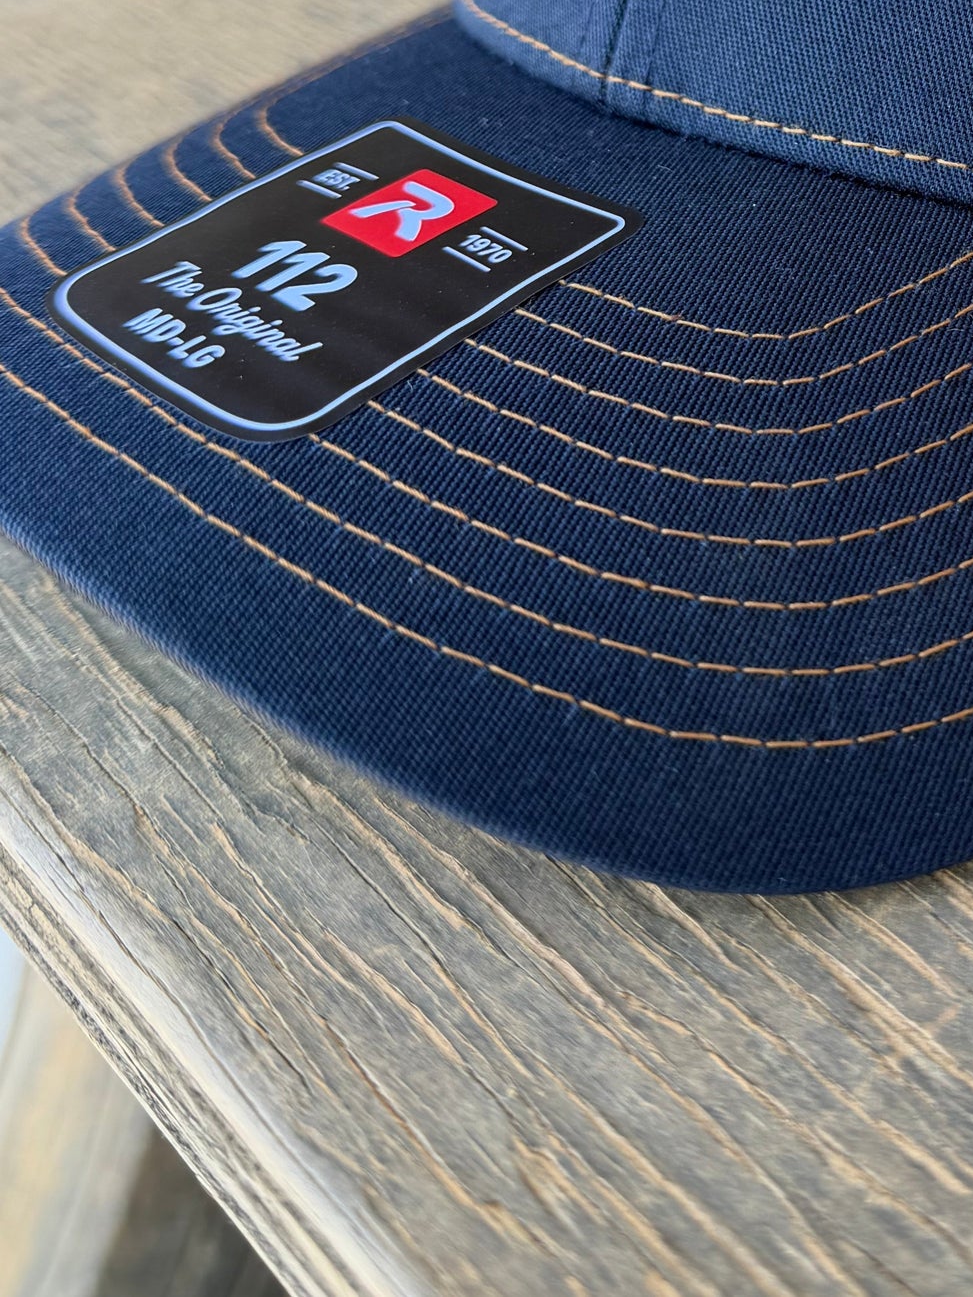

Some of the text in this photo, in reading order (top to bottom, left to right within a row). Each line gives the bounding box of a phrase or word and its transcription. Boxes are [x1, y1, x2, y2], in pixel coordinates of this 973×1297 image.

[231, 240, 358, 311] 112
[460, 232, 513, 264] 1970
[122, 307, 227, 369] MD-LG
[141, 261, 323, 363] The Original
